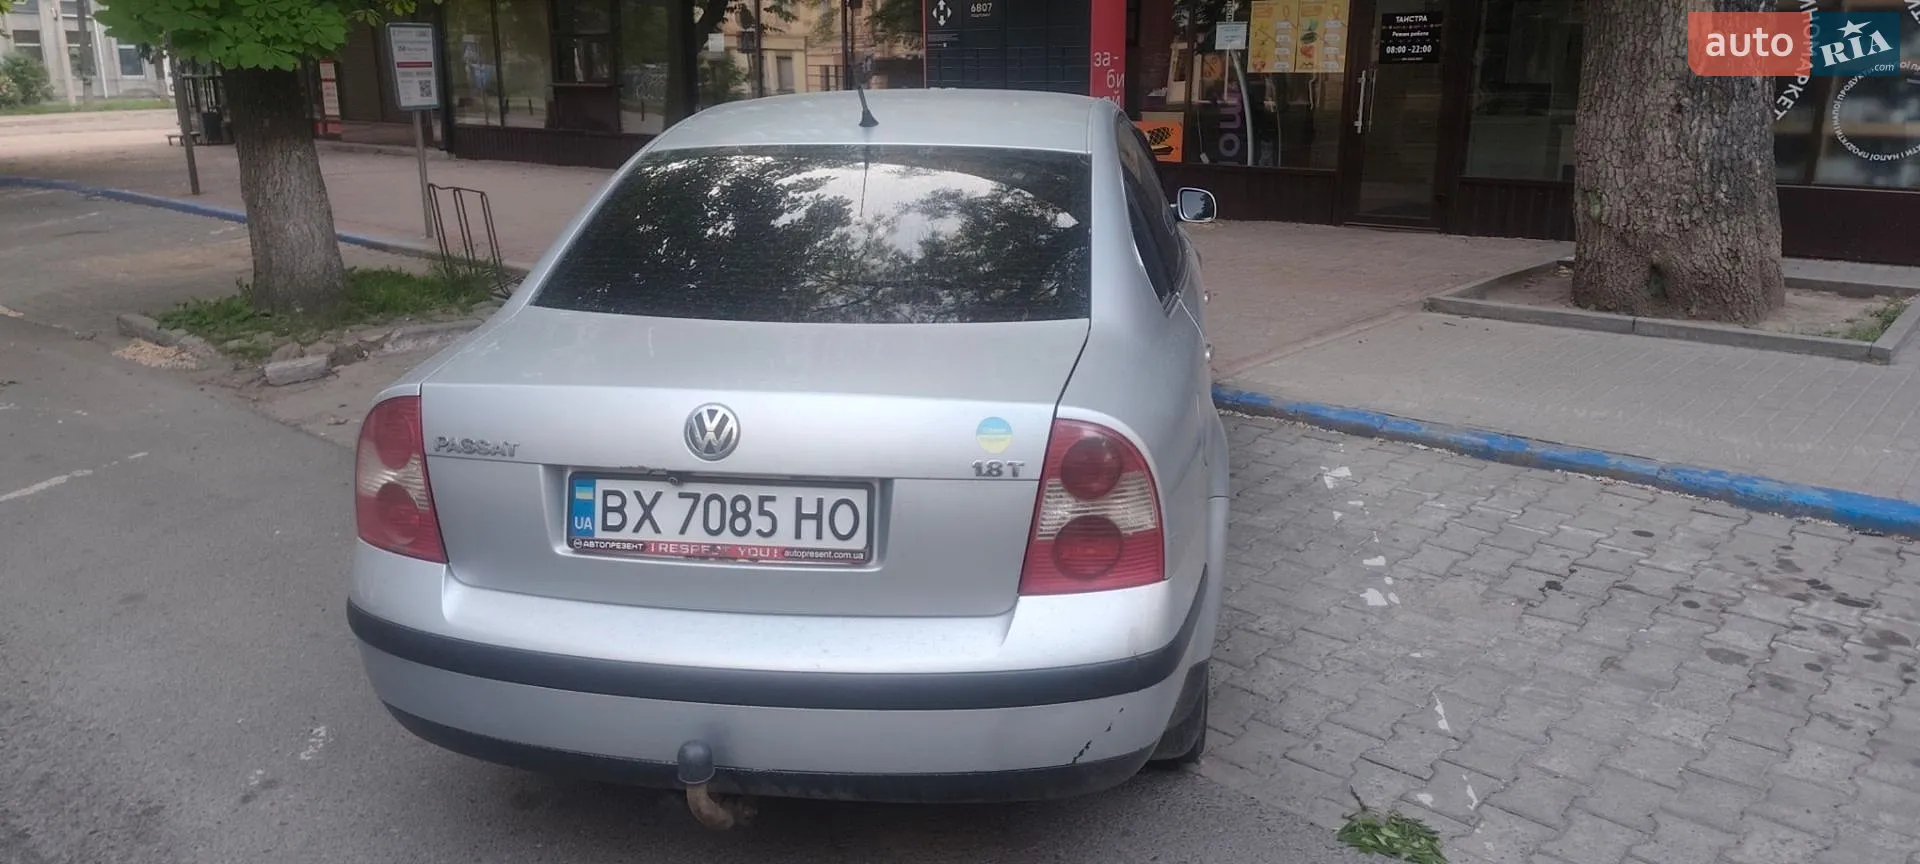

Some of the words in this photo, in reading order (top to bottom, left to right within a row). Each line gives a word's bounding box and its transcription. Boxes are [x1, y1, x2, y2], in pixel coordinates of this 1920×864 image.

[970, 2, 992, 13] 6807
[433, 435, 520, 457] PASSAT
[1007, 460, 1025, 478] T
[601, 489, 664, 535] BX
[677, 492, 778, 538] 7085
[795, 496, 860, 542] HO
[574, 516, 593, 531] UA
[583, 540, 644, 551] АВТОПРЕЗЕНТ
[783, 549, 864, 561] autopresent.com.ua
